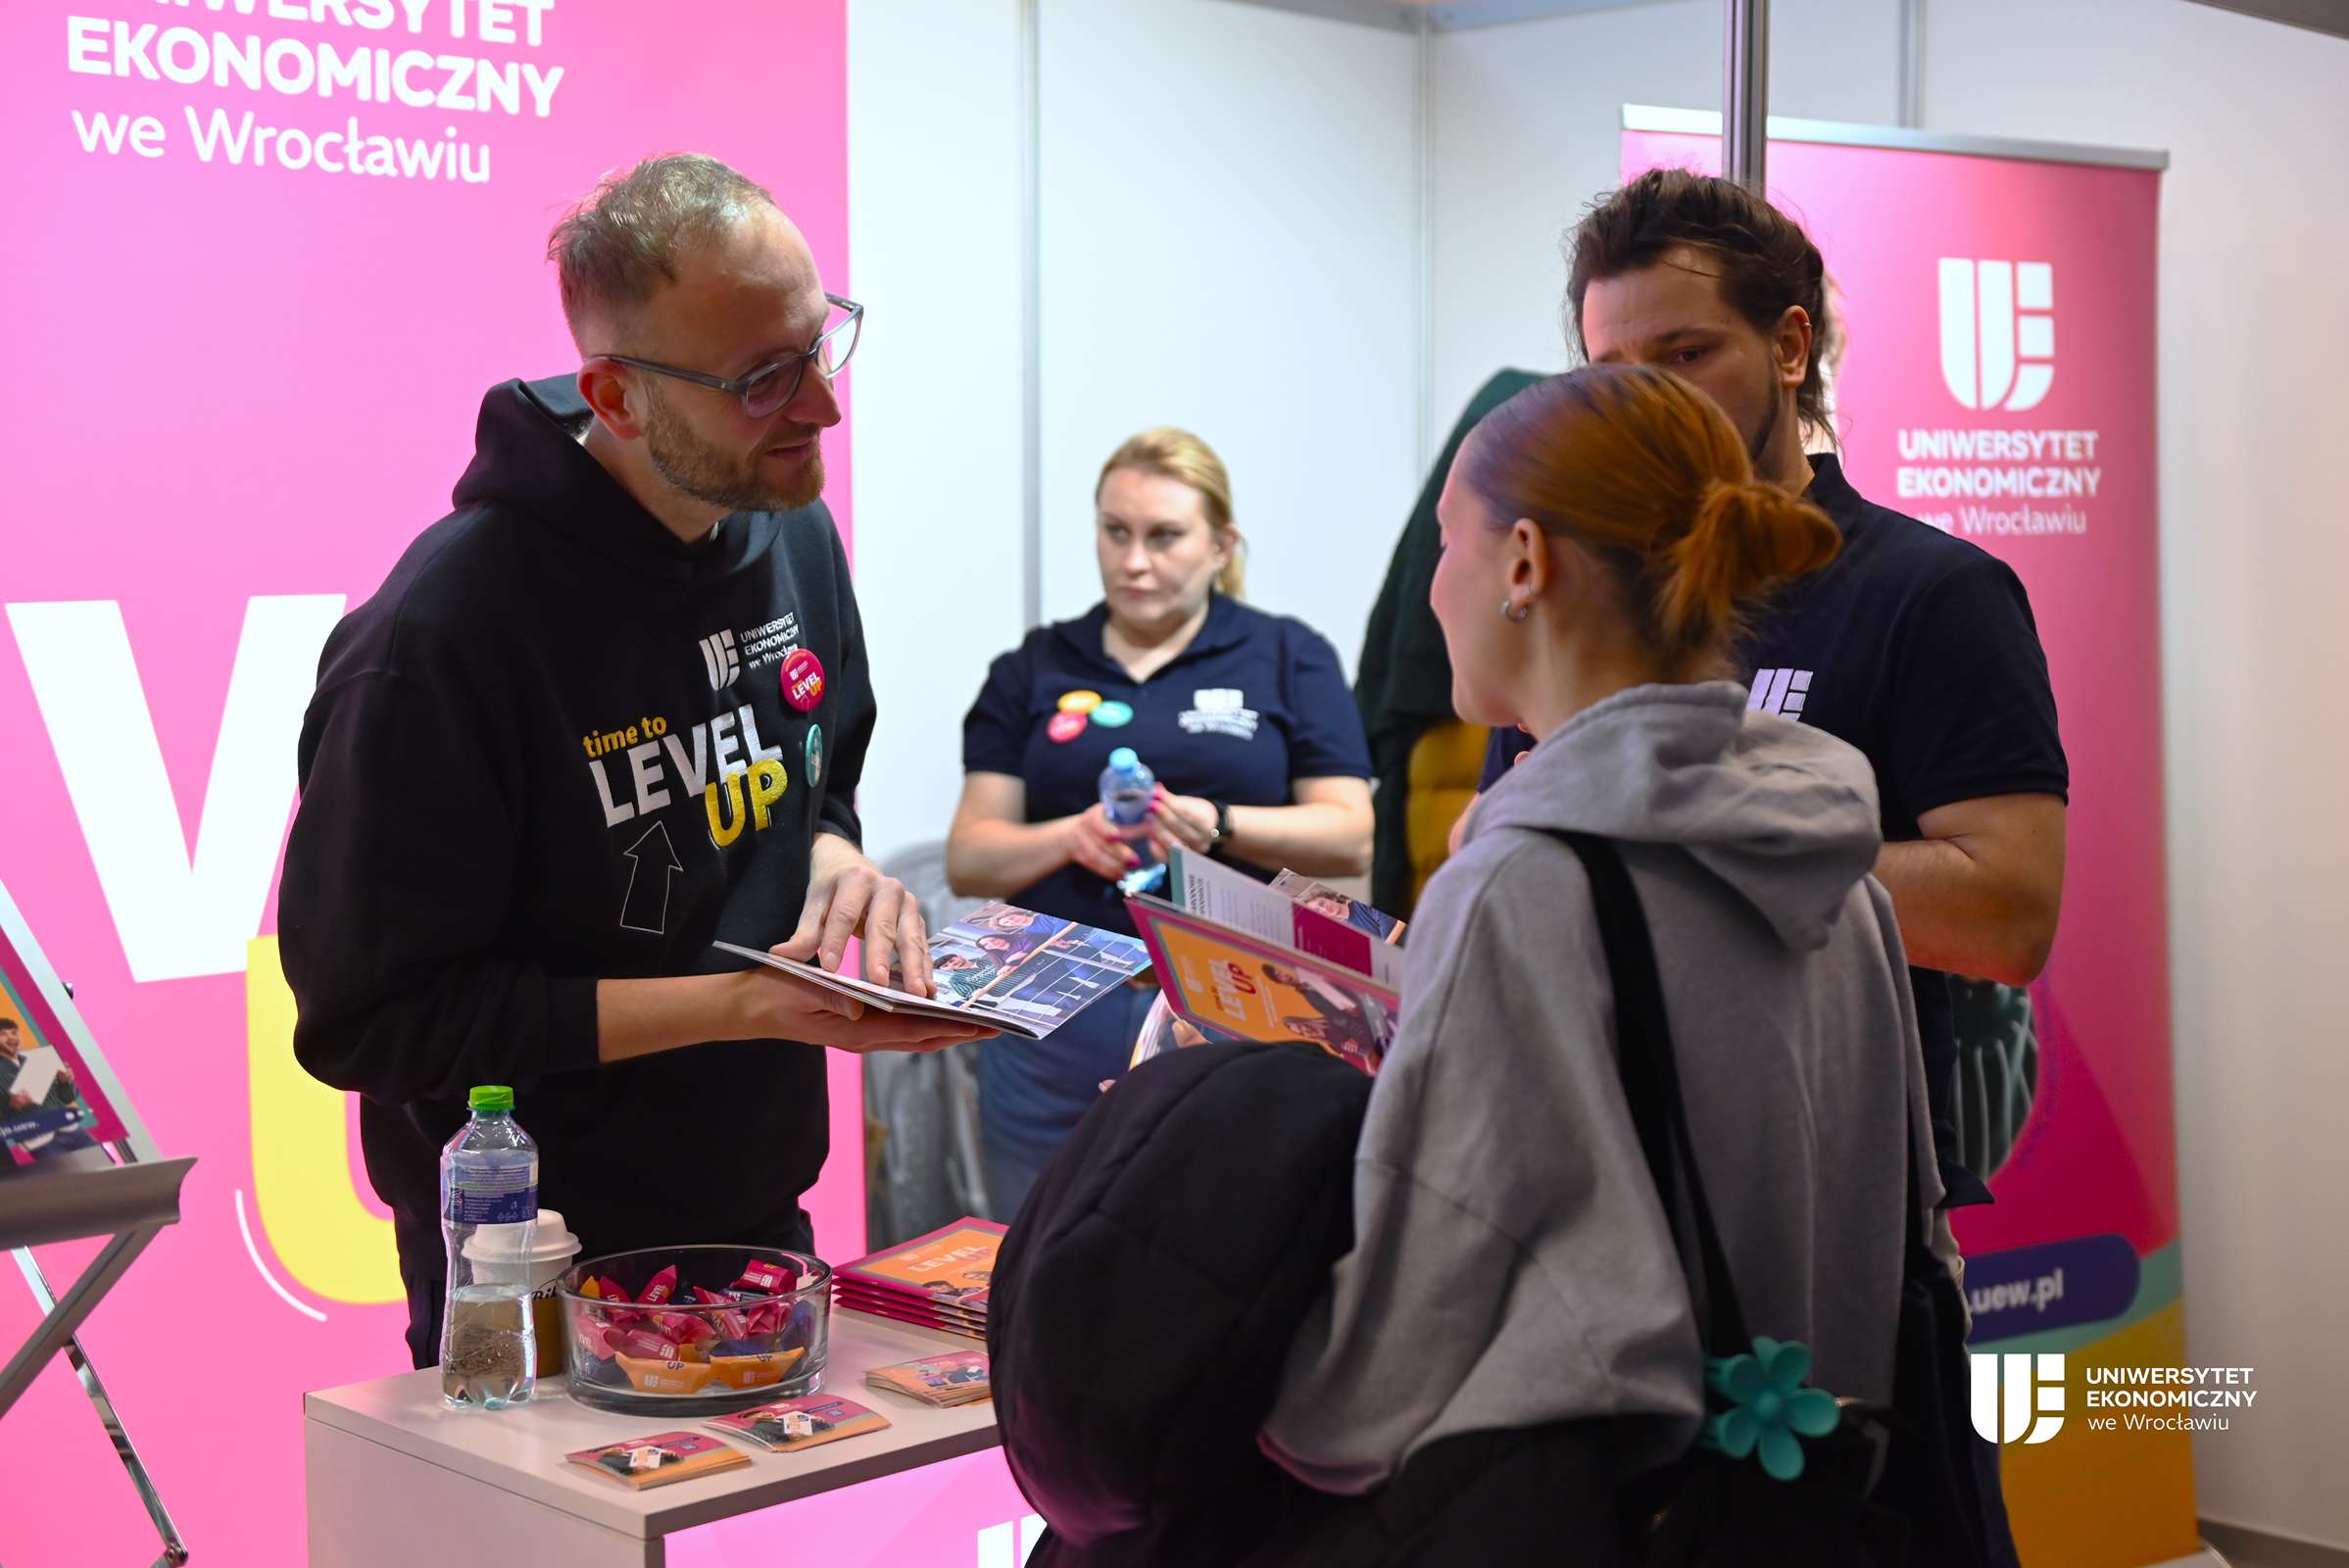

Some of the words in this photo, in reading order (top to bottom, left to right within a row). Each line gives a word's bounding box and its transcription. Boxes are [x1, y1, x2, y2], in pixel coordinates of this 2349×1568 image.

[67, 15, 564, 118] EKONOMICZNY
[72, 109, 166, 158] we
[184, 105, 491, 183] Wrocławiu
[1897, 428, 2099, 461] UNIWERSYTET
[1896, 466, 2101, 499] EKONOMICZNY
[1960, 503, 2087, 535] Wrocławiu
[583, 727, 639, 759] time
[641, 715, 667, 737] to
[589, 704, 784, 828] LEVEL
[705, 758, 788, 849] UP
[908, 1246, 989, 1272] LEVEL
